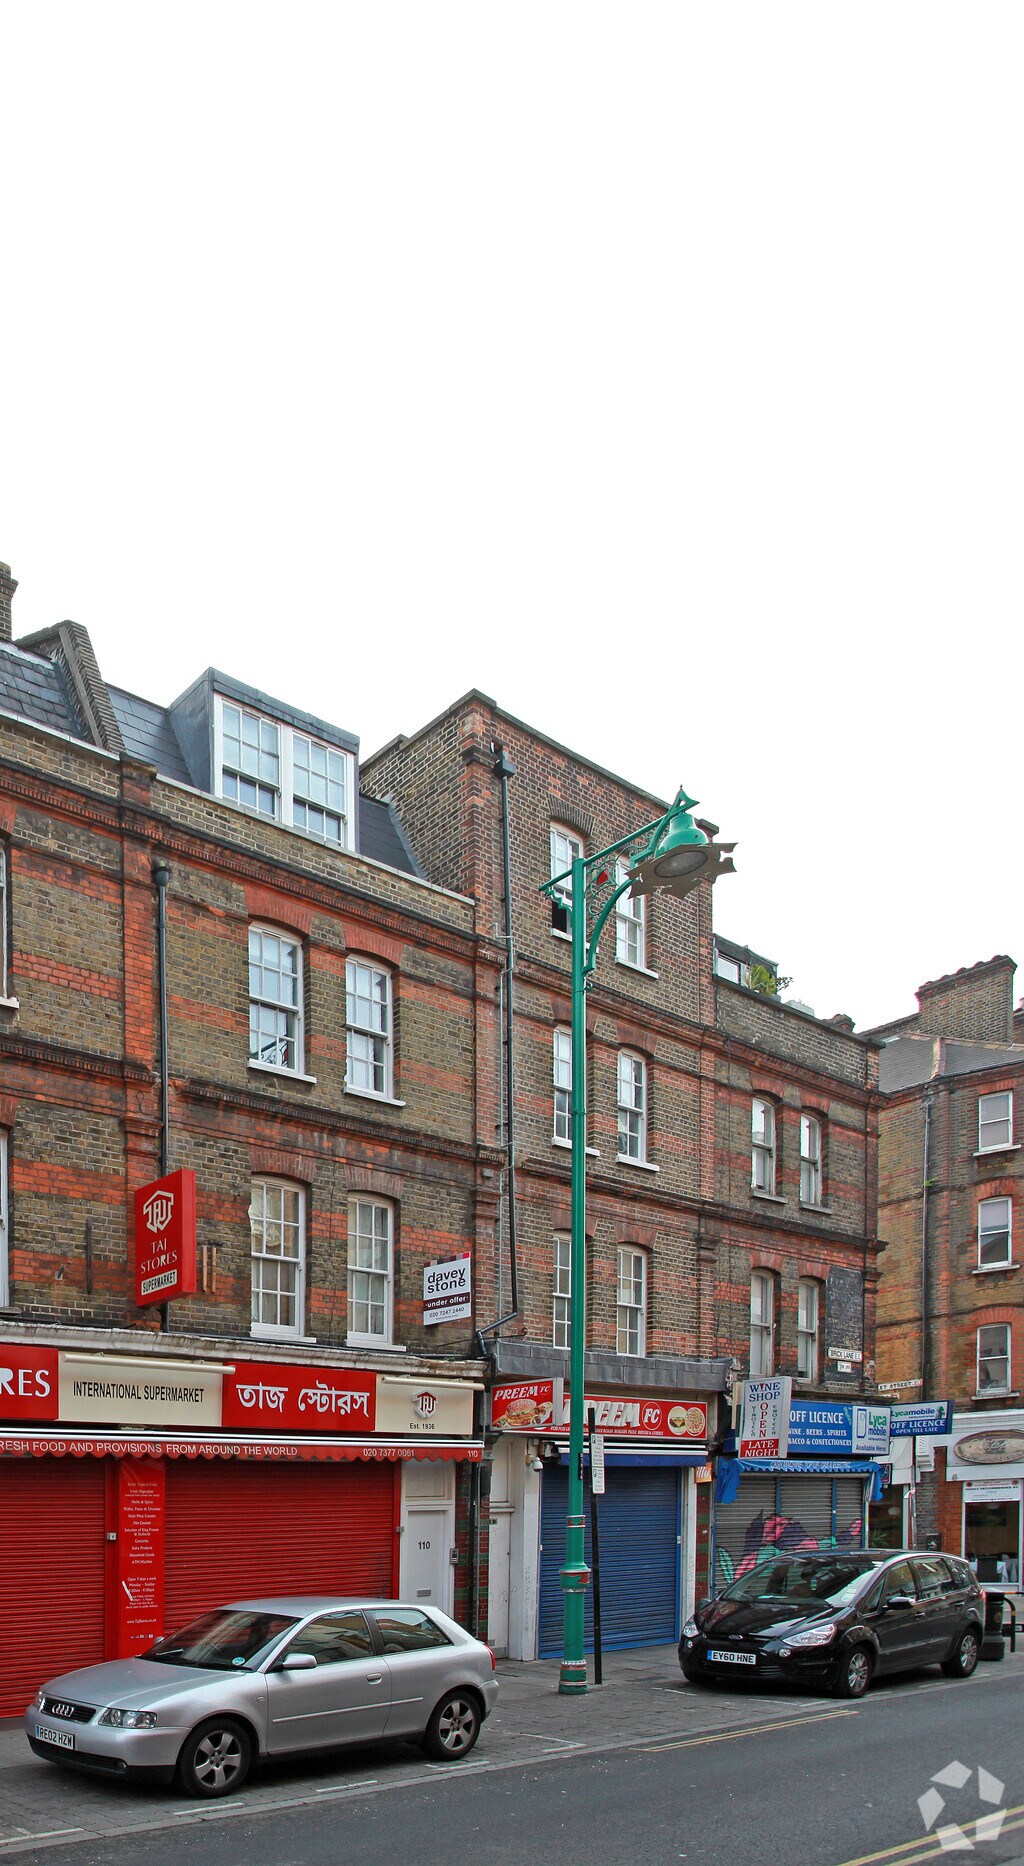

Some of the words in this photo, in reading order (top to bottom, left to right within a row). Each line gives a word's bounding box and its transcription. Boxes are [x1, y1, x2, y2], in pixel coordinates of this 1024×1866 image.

[141, 1250, 178, 1274] STORES
[142, 1271, 176, 1293] SUPERMARKET
[427, 1268, 466, 1284] davey
[427, 1278, 466, 1293] stone
[427, 1299, 448, 1308] under
[449, 1296, 466, 1304] offer
[830, 1350, 843, 1358] BRICK
[844, 1351, 854, 1359] LANE
[73, 1381, 142, 1401] INTERNATIONAL
[143, 1386, 205, 1403] SUPERMARKET
[235, 1381, 289, 1413] তাজ
[494, 1386, 539, 1401] PREEM
[749, 1391, 781, 1403] SHOP
[643, 1408, 661, 1424] FC
[759, 1402, 769, 1438] OPEN
[789, 1410, 807, 1423] OFF
[809, 1411, 844, 1424] LICENCE
[868, 1411, 887, 1428] Lyca
[409, 1422, 421, 1430] Est.
[891, 1421, 907, 1429] OFF
[909, 1419, 945, 1428] LICENCE
[827, 1429, 847, 1437] SPIRITS
[868, 1426, 887, 1436] mobile
[32, 1441, 67, 1452] FOOD
[69, 1442, 94, 1452] AND
[96, 1442, 163, 1453] PROVISIONS
[166, 1444, 197, 1454] FROM
[198, 1444, 241, 1455] AROUND
[242, 1446, 262, 1455] THE
[263, 1446, 298, 1456] WORLD
[748, 1440, 775, 1449] LATE
[812, 1438, 851, 1446] CONFECTIONERY
[363, 1448, 377, 1457] 020
[378, 1448, 396, 1457] 7377
[397, 1449, 415, 1457] 0061
[467, 1450, 478, 1458] 110
[745, 1448, 779, 1458] NIGHT
[417, 1541, 431, 1549] 110
[712, 1651, 735, 1662] EY60
[736, 1654, 754, 1664] HNE
[39, 1727, 57, 1742] RE02
[58, 1733, 72, 1747] HZW
